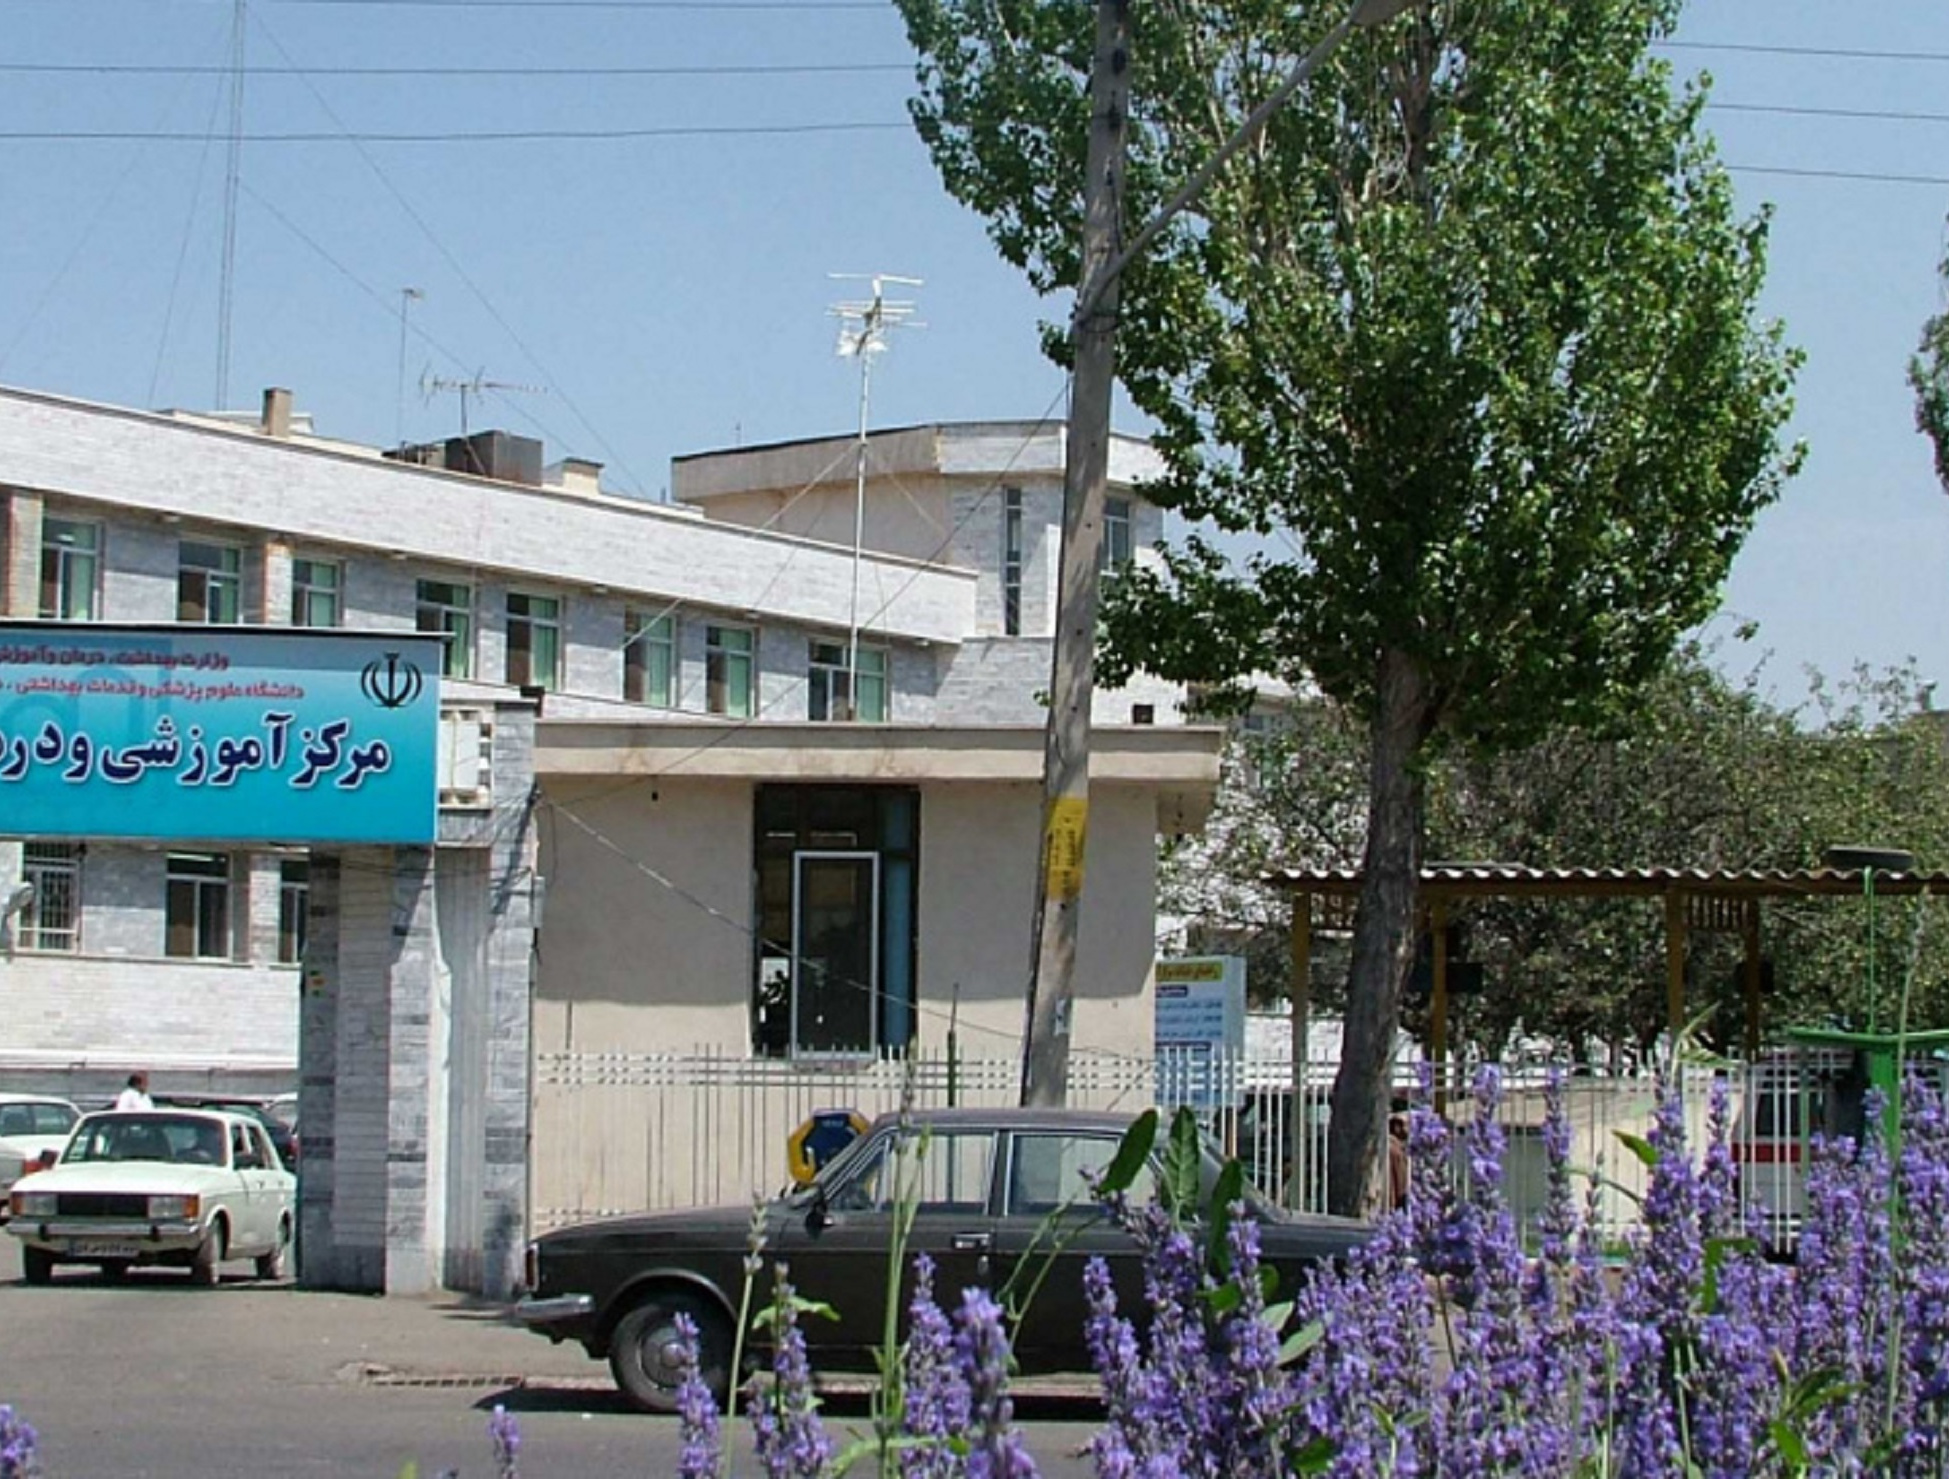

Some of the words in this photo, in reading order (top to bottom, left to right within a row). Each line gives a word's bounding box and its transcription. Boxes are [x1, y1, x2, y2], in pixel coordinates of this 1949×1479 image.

[205, 682, 242, 701] علوم
[245, 680, 304, 699] دانشگاه
[101, 711, 292, 787] آموزشی
[290, 719, 389, 788] مرکز
